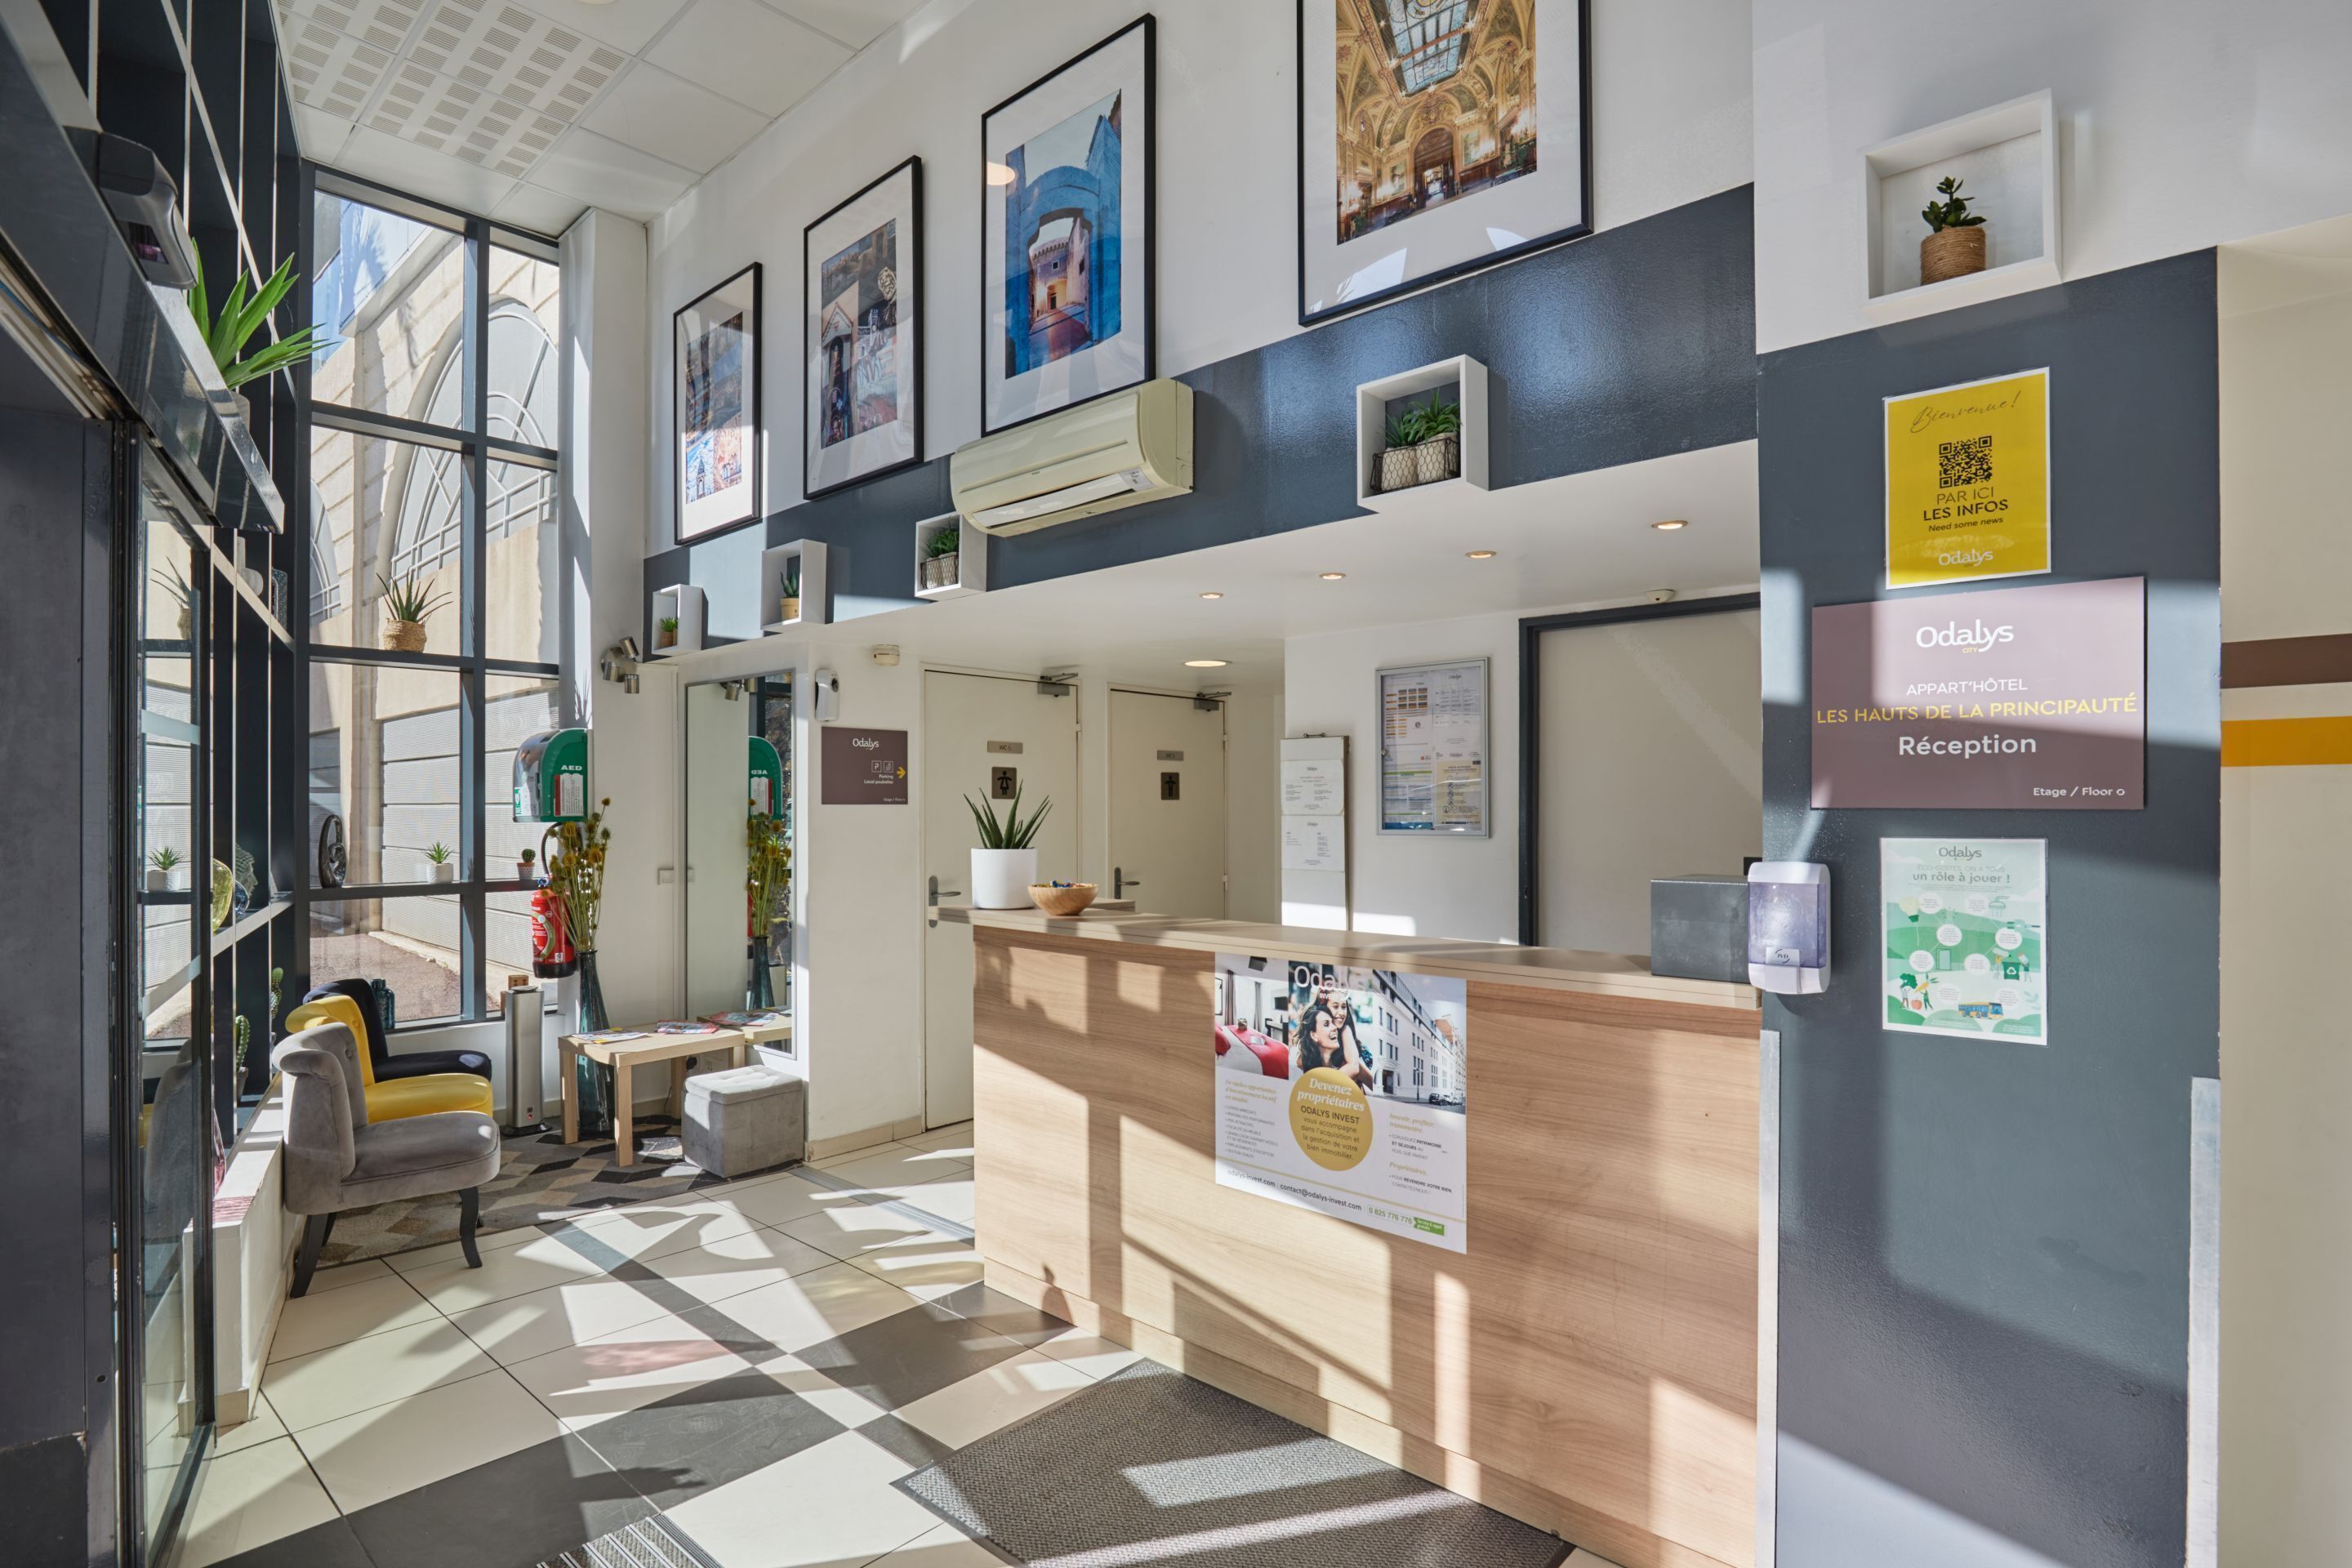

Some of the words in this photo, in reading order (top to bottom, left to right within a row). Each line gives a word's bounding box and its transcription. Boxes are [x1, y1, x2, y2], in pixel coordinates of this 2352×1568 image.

[1936, 490, 1967, 505] PAR
[1972, 486, 1994, 501] ICI
[1923, 507, 1951, 521] LES
[1957, 499, 2008, 516] INFOS
[1928, 523, 1952, 532] Need
[1953, 521, 1978, 529] some
[1980, 517, 2004, 526] news
[1939, 549, 1993, 567] Odalys
[1916, 619, 2014, 652] Odalys
[1906, 678, 2027, 696] APPART'HÔTEL
[1817, 709, 1847, 724] LES
[1855, 706, 1918, 722] HAUTS
[1926, 705, 1952, 719] DE
[1958, 703, 1984, 719] LA
[1990, 693, 2137, 717] PRINCIPAUTÉ
[853, 737, 880, 750] Odalys
[1899, 733, 2037, 759] Réception
[2034, 787, 2066, 798] Etage
[2070, 786, 2078, 797] /
[2082, 786, 2112, 795] Floor
[1939, 846, 1981, 861] Odalys
[1931, 871, 1955, 882] rôle
[1958, 872, 1965, 882] à
[1968, 872, 2002, 884] jouer
[2007, 875, 2011, 883] !
[1309, 1078, 1352, 1095] Devenez
[1297, 1091, 1365, 1111] propriétaires
[1300, 1106, 1330, 1118] ODALYS
[1332, 1113, 1360, 1125] INVEST
[1301, 1125, 1315, 1133] dans
[1319, 1120, 1357, 1134] accompagne
[1310, 1135, 1331, 1145] gestion
[1343, 1143, 1358, 1152] votre
[1398, 1142, 1416, 1150] SÉJOURS
[1416, 1140, 1442, 1148] PATRIMOINE
[1321, 1148, 1354, 1160] immobilier.
[1227, 1169, 1276, 1187] odalys-invest.com
[1403, 1178, 1425, 1187] REVENDRE
[1426, 1183, 1441, 1191] VOTRE
[1280, 1183, 1362, 1212] contact@odalys-invest.com
[1374, 1209, 1385, 1218] 825
[1388, 1212, 1399, 1221] 776
[1400, 1216, 1413, 1225] 776
